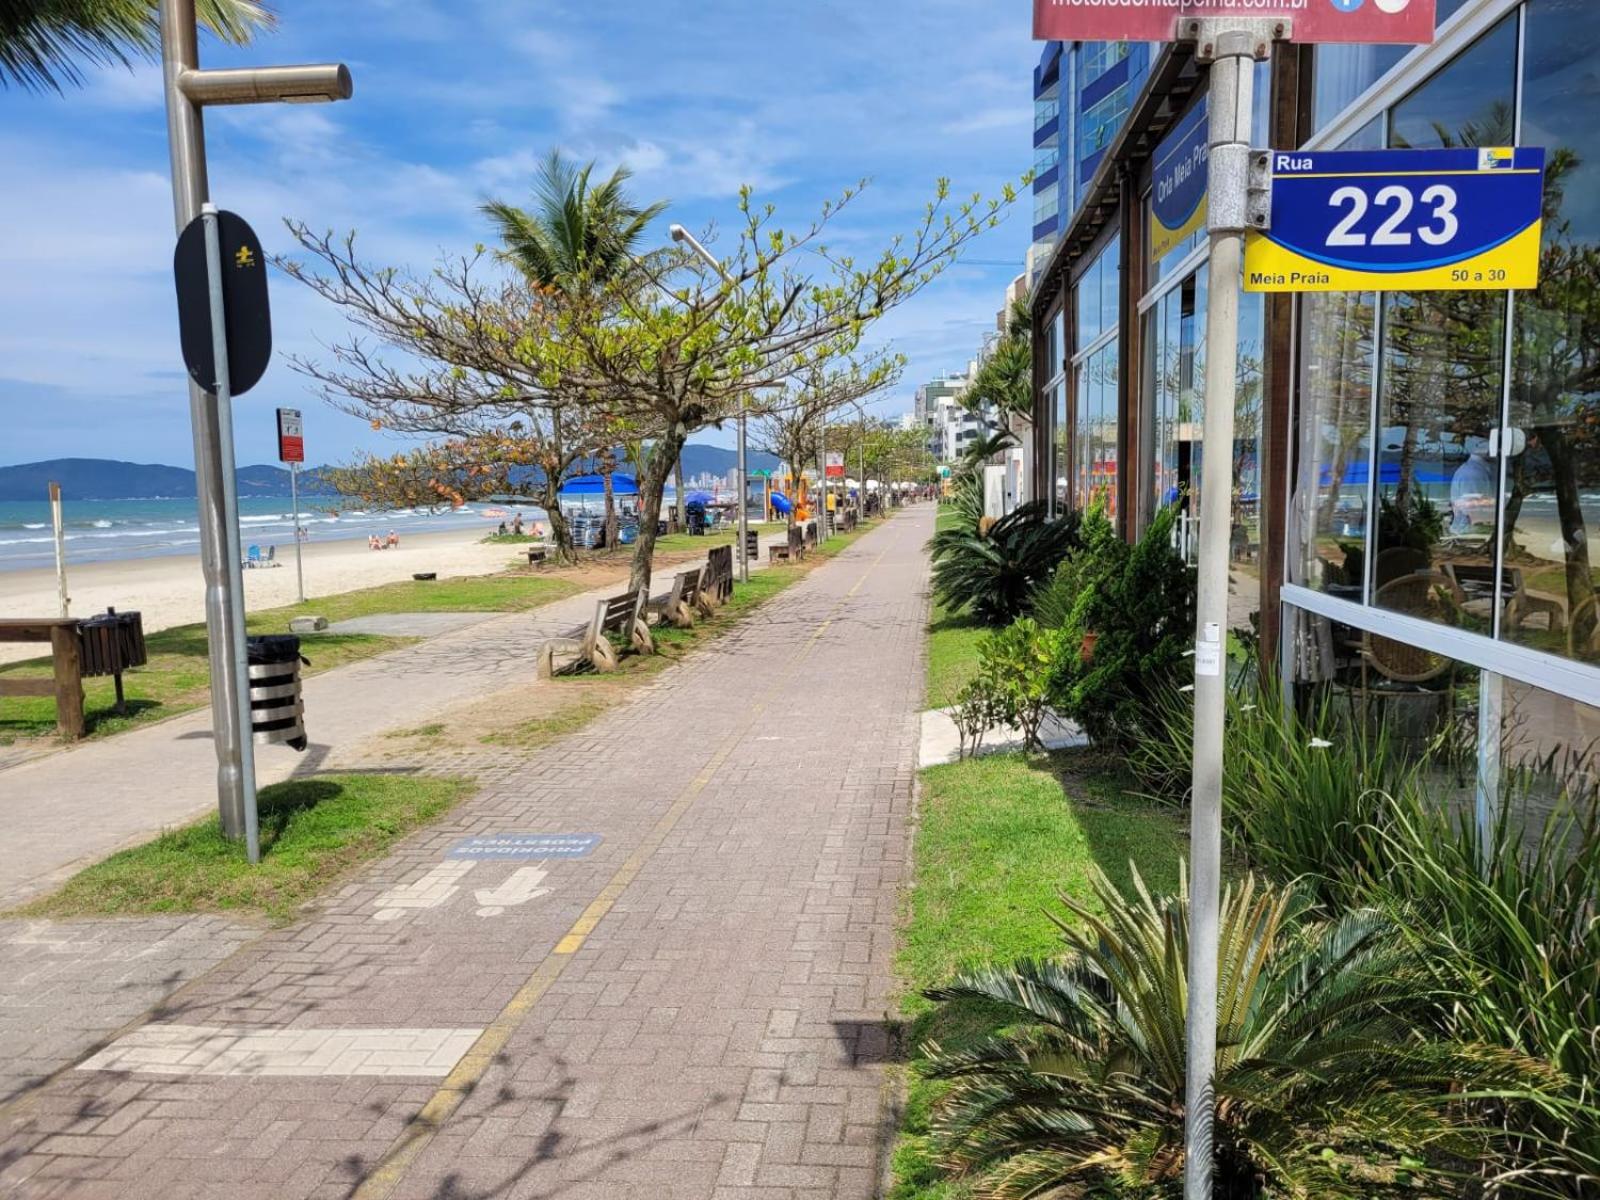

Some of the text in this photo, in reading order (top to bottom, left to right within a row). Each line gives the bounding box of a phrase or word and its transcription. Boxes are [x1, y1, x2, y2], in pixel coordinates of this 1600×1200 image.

[1276, 155, 1313, 171] Rua
[1157, 174, 1173, 203] Orla
[1174, 156, 1192, 189] Meia
[1325, 184, 1459, 247] 223
[1249, 271, 1330, 286] Meia Praia
[1451, 269, 1506, 282] 50 a 30
